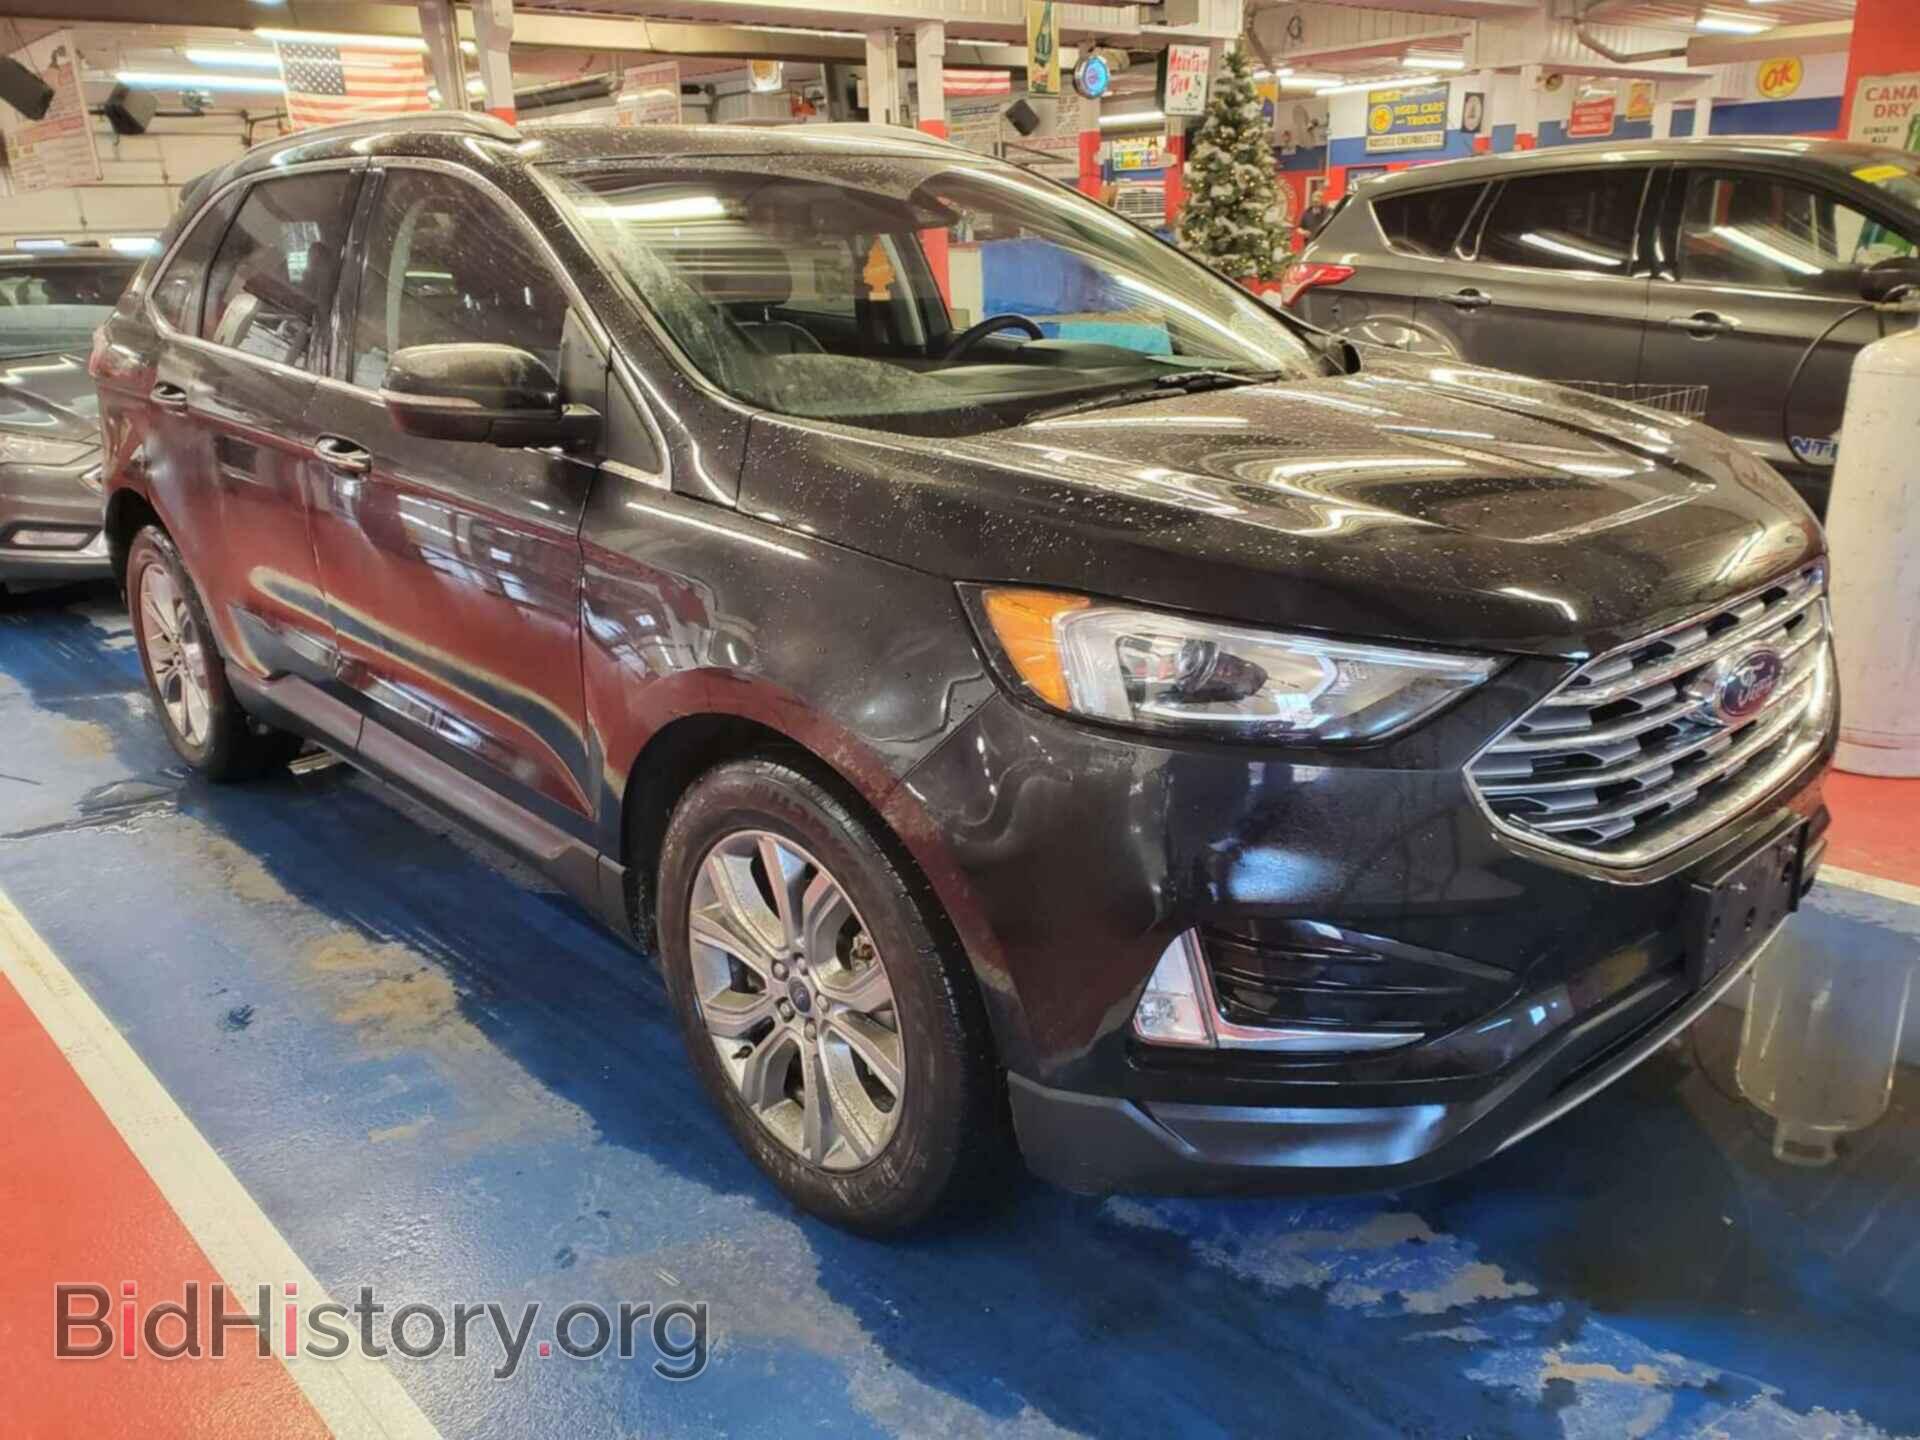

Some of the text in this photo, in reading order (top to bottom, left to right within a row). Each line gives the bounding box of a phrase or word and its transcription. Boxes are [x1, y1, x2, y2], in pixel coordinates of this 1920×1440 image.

[1763, 62, 1793, 91] OK
[1874, 102, 1912, 118] DRY
[1736, 660, 1776, 708] Ford
